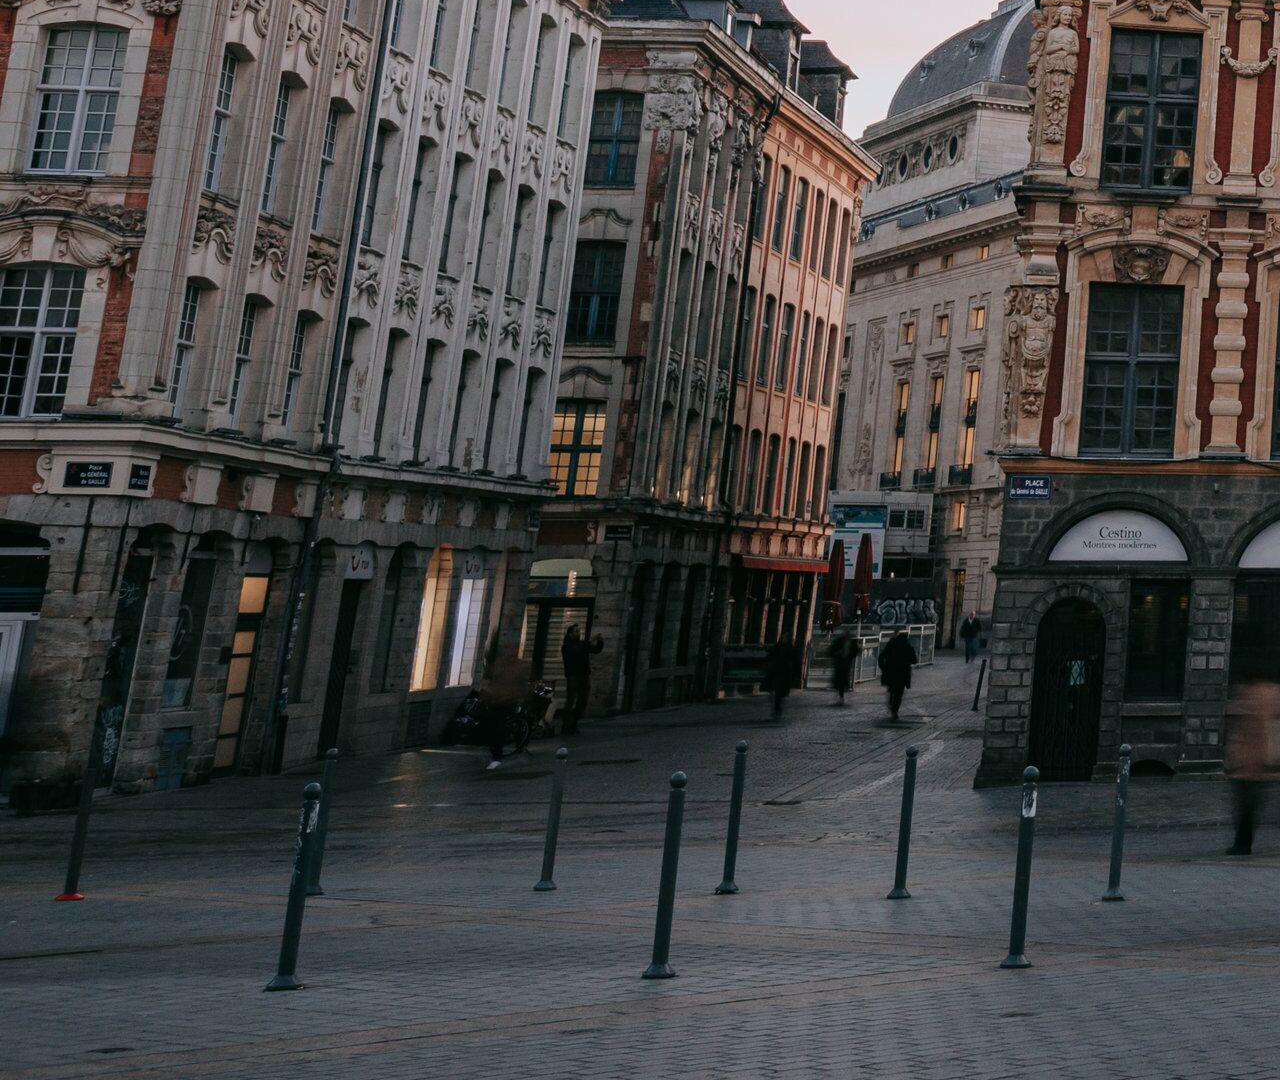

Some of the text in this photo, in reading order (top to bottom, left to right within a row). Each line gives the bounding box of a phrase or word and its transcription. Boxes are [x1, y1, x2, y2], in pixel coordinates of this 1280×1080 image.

[1025, 479, 1045, 487] PLACE
[1099, 526, 1142, 539] Cestino
[1082, 540, 1157, 549] Montres modernes
